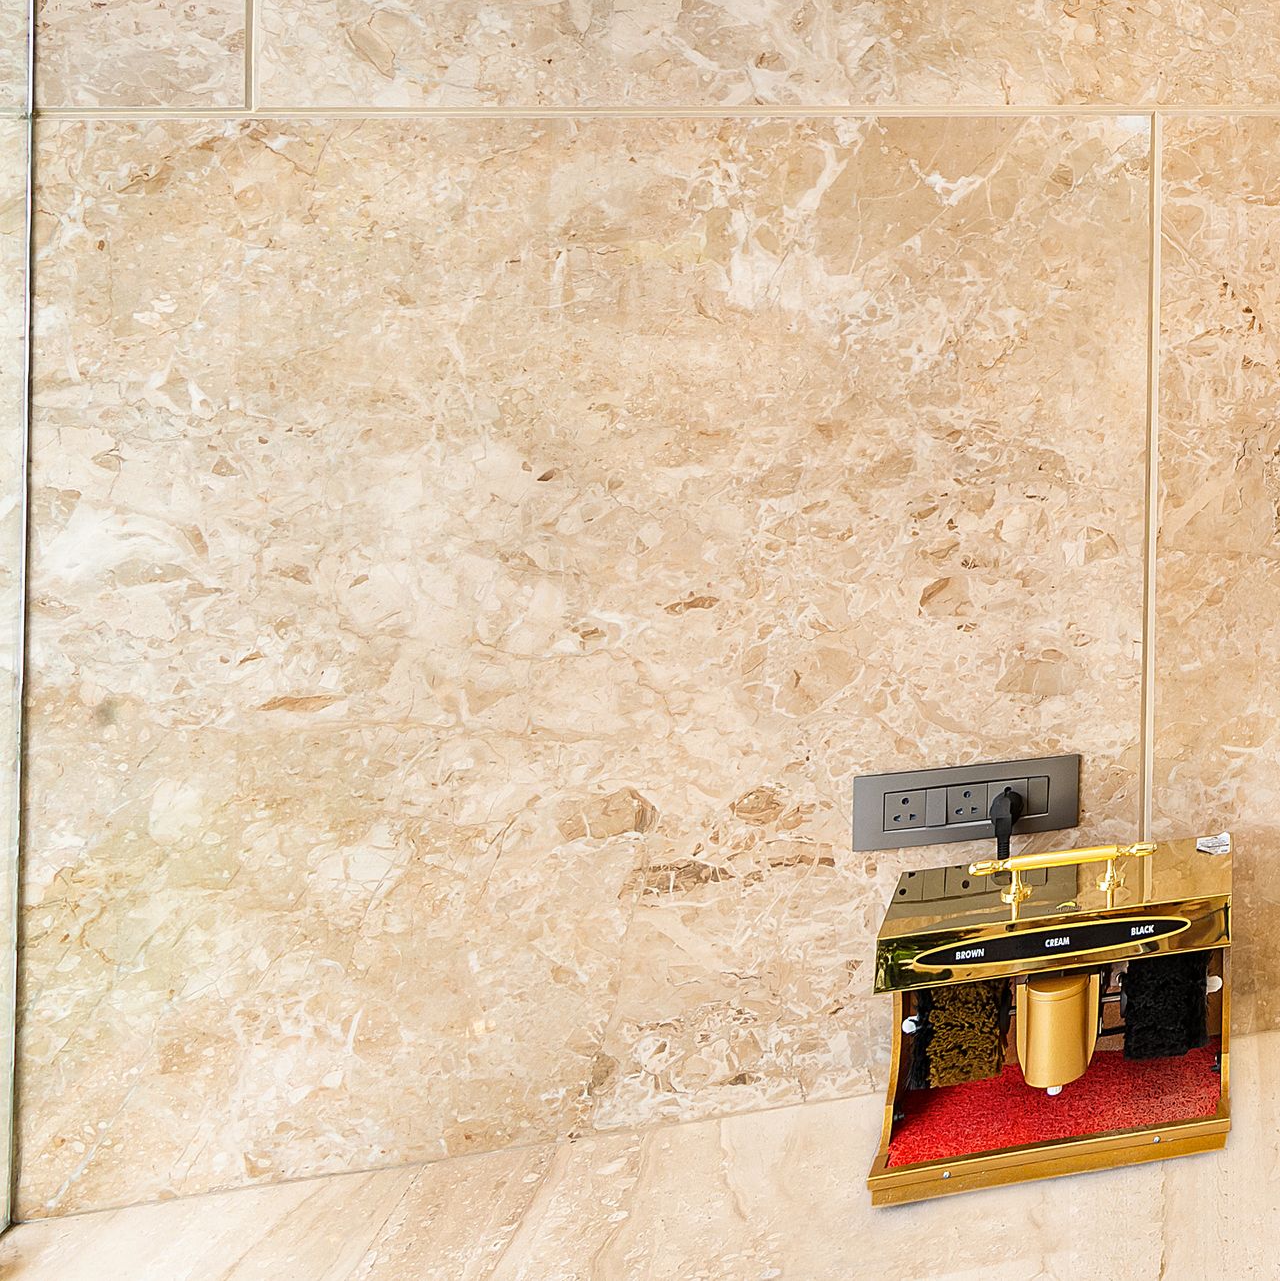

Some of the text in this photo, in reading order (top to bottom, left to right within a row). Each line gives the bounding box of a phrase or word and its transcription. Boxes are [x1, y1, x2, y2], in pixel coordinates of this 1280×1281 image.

[955, 924, 1155, 960] BROWN CREAM BLACK
